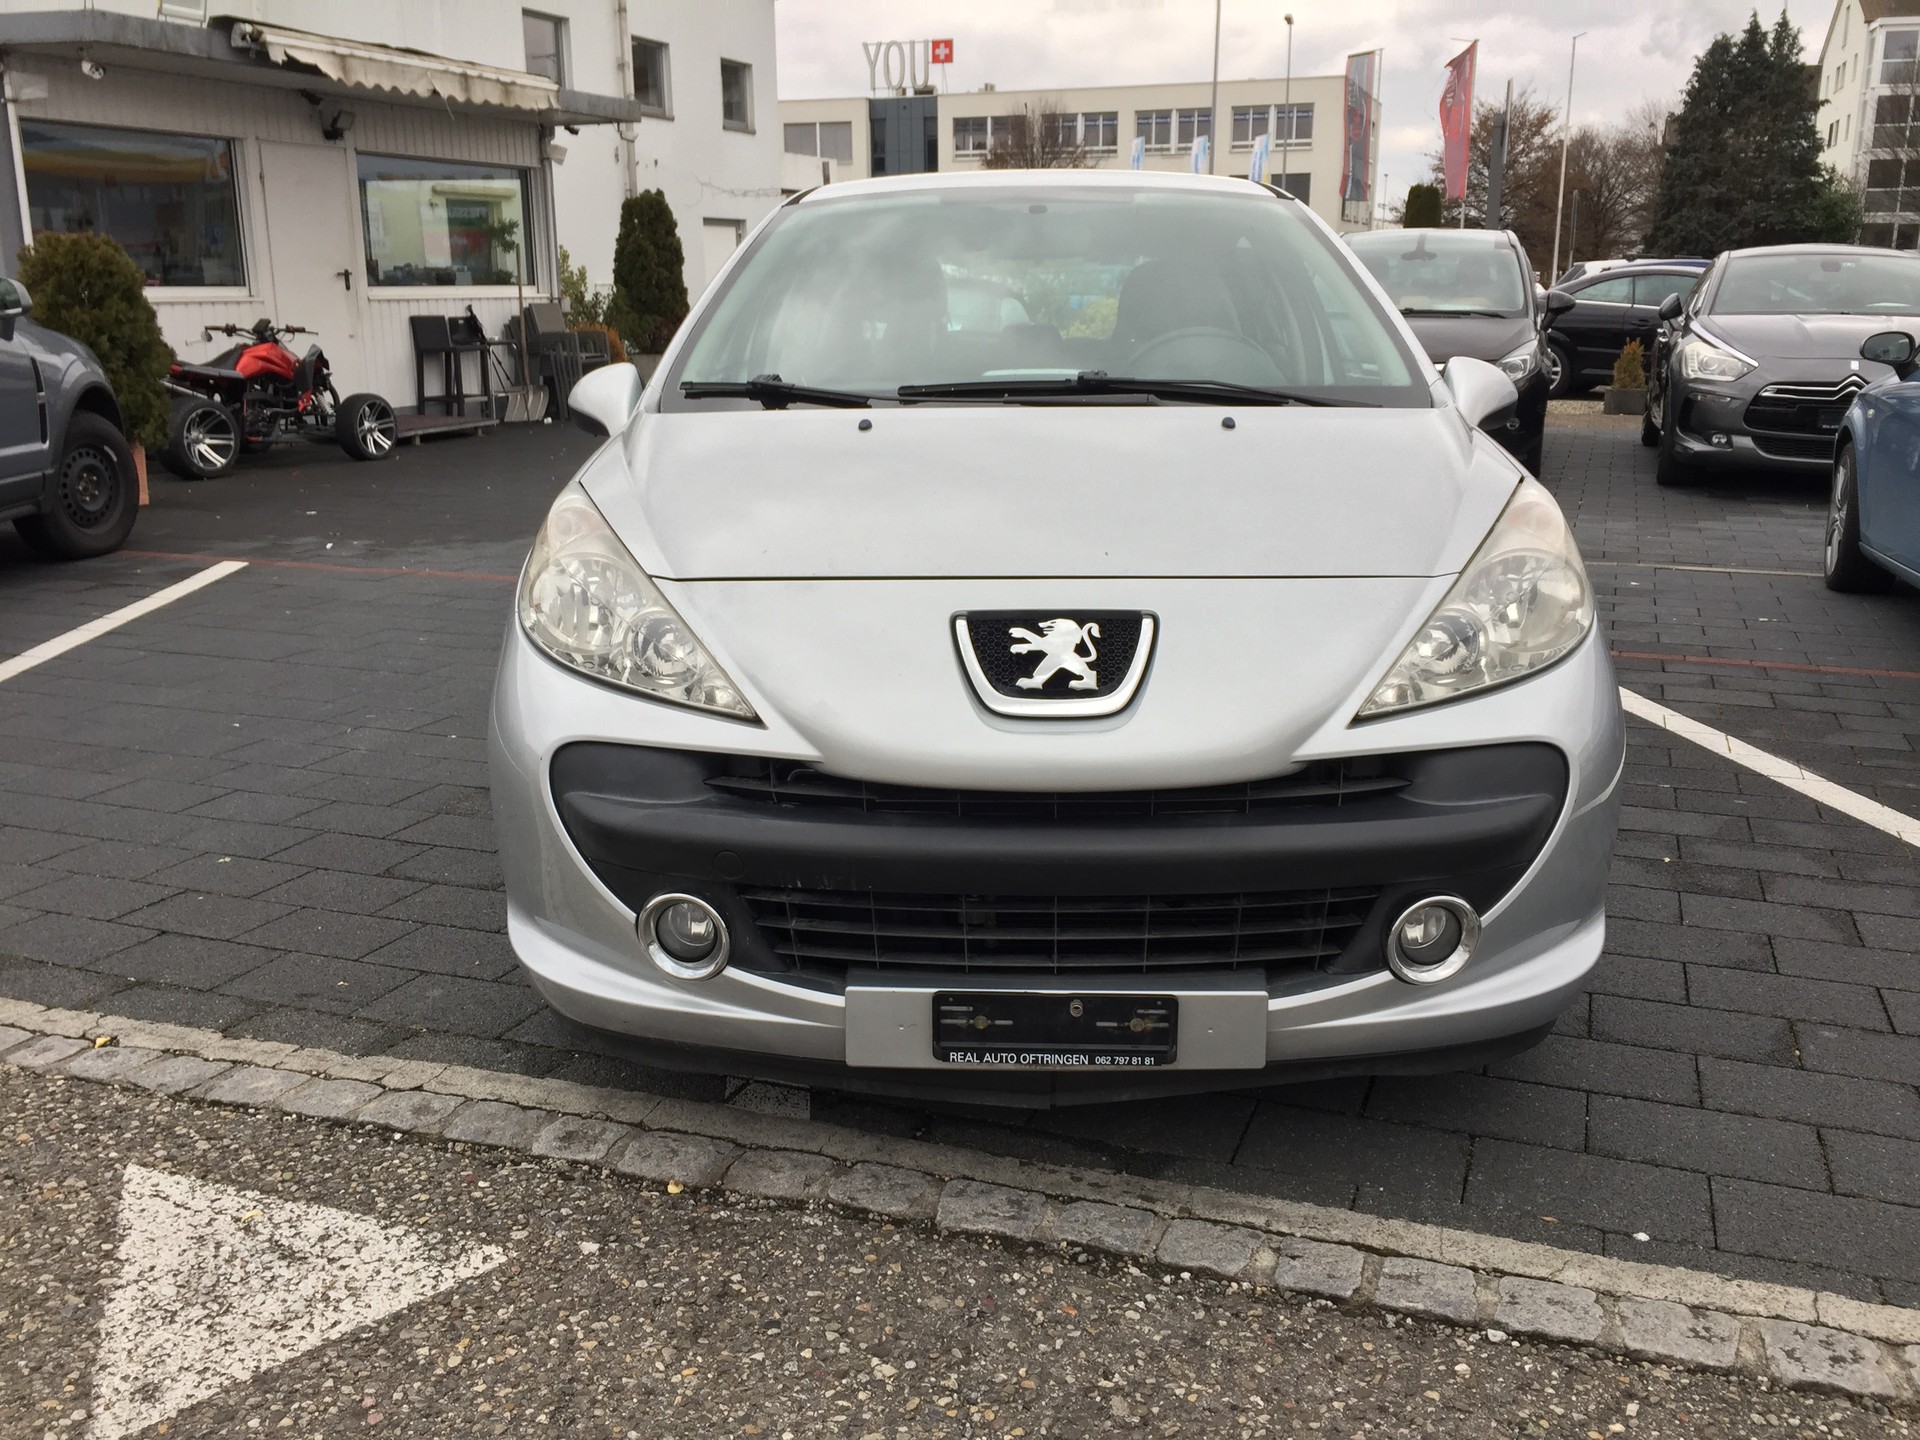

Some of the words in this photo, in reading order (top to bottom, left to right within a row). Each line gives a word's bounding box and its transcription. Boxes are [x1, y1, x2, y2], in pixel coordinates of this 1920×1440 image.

[862, 39, 929, 91] YOU
[949, 1052, 980, 1063] REAL
[983, 1052, 1017, 1064] AUTO
[1020, 1053, 1089, 1065] OFTRINGEN
[1095, 1056, 1112, 1065] 062
[1113, 1056, 1130, 1065] 797
[1131, 1056, 1142, 1065] 81
[1144, 1057, 1155, 1066] 81
